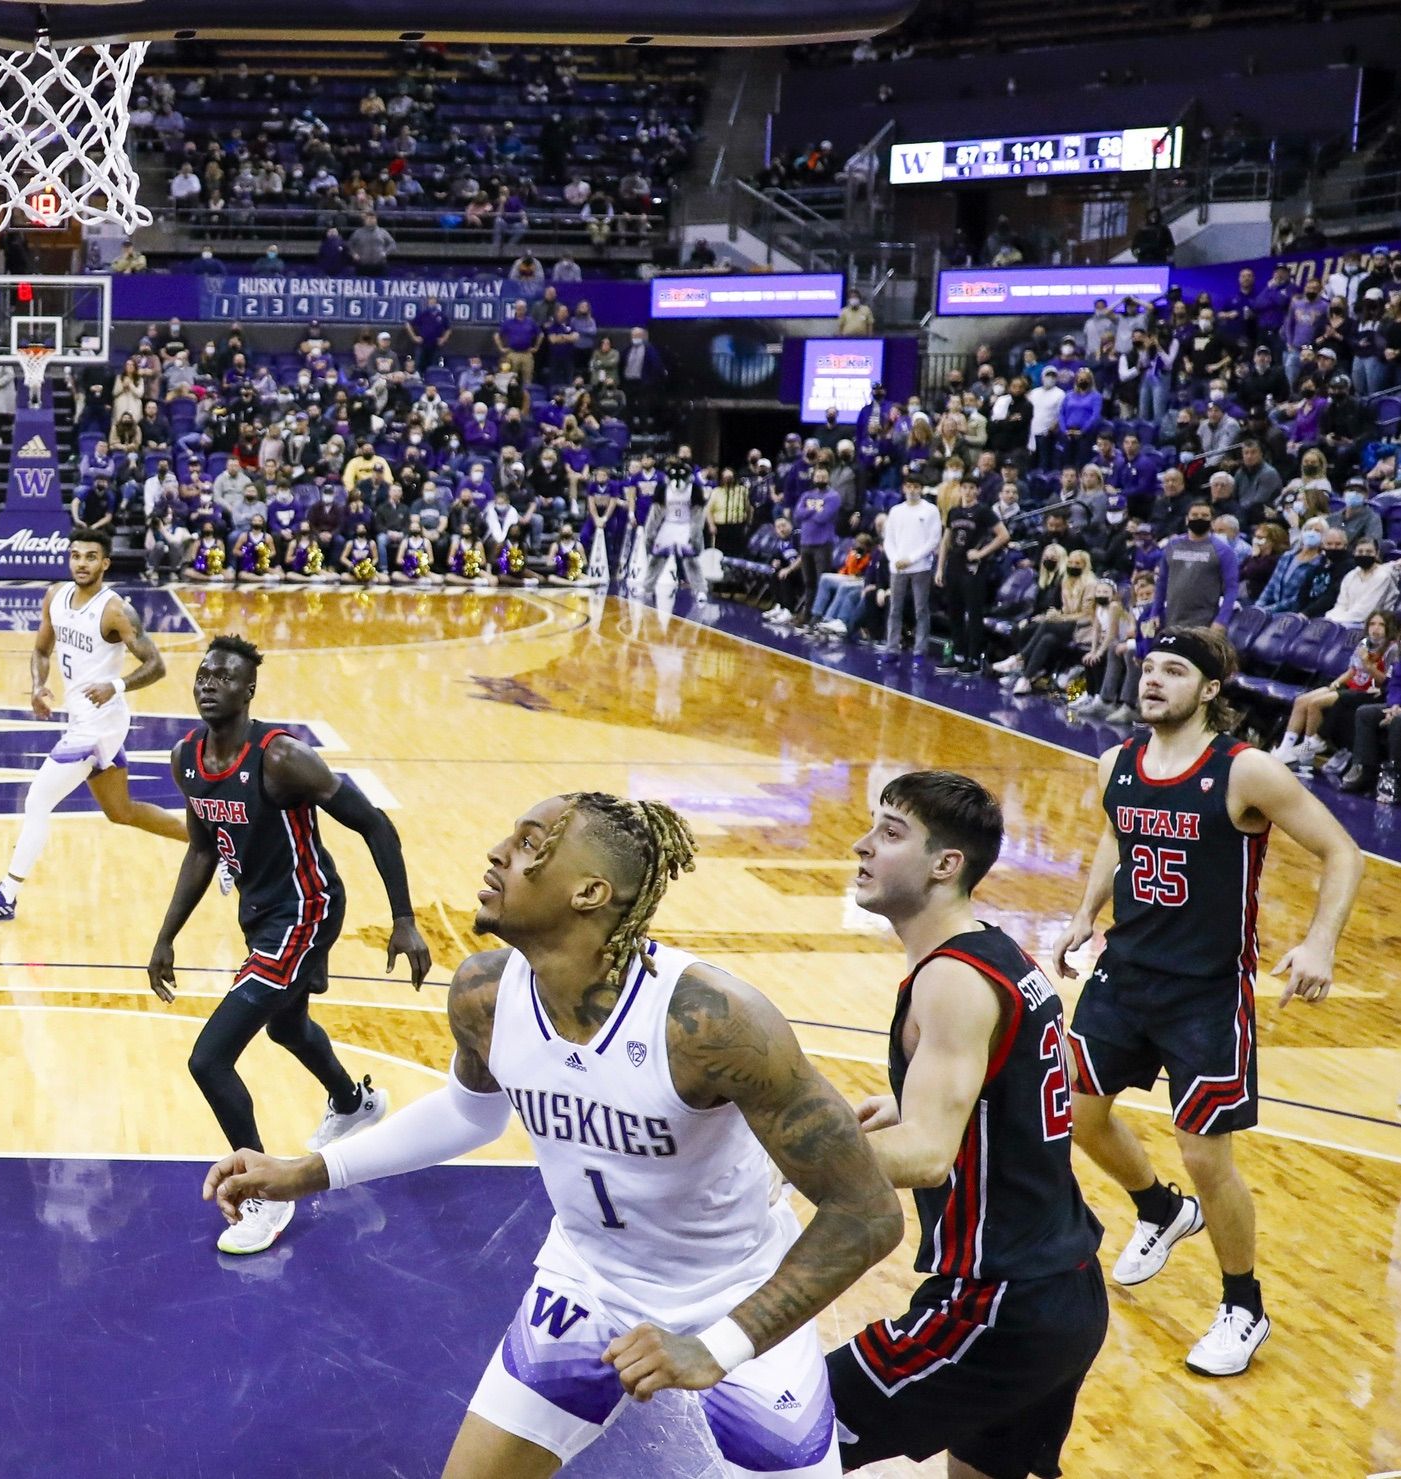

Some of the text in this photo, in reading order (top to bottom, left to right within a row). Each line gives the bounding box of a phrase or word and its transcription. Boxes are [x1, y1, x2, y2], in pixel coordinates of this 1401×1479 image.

[956, 146, 979, 164] 57
[1012, 141, 1053, 161] 1:14
[238, 277, 286, 295] HUSKY
[290, 278, 378, 297] BASKETBALL
[382, 279, 458, 299] TAKEAWAY
[245, 298, 258, 315] 2
[272, 298, 283, 315] 3
[297, 297, 309, 315] 4
[321, 298, 334, 315] 5
[349, 299, 361, 316] 6
[378, 300, 389, 317] 7
[404, 302, 416, 319] 8
[453, 303, 470, 319] 10
[481, 302, 493, 319] 11
[14, 468, 55, 497] W
[0, 555, 64, 565] AIRLINES
[62, 653, 72, 680] 5
[189, 796, 249, 824] UTAH
[1117, 806, 1200, 840] UTAH
[217, 827, 242, 874] 2
[1131, 844, 1189, 906] 25
[564, 1061, 588, 1073] adidas
[505, 1087, 678, 1157] HUSKIES
[584, 1167, 626, 1230] 1
[530, 1286, 589, 1340] W
[773, 1401, 802, 1410] adidas
